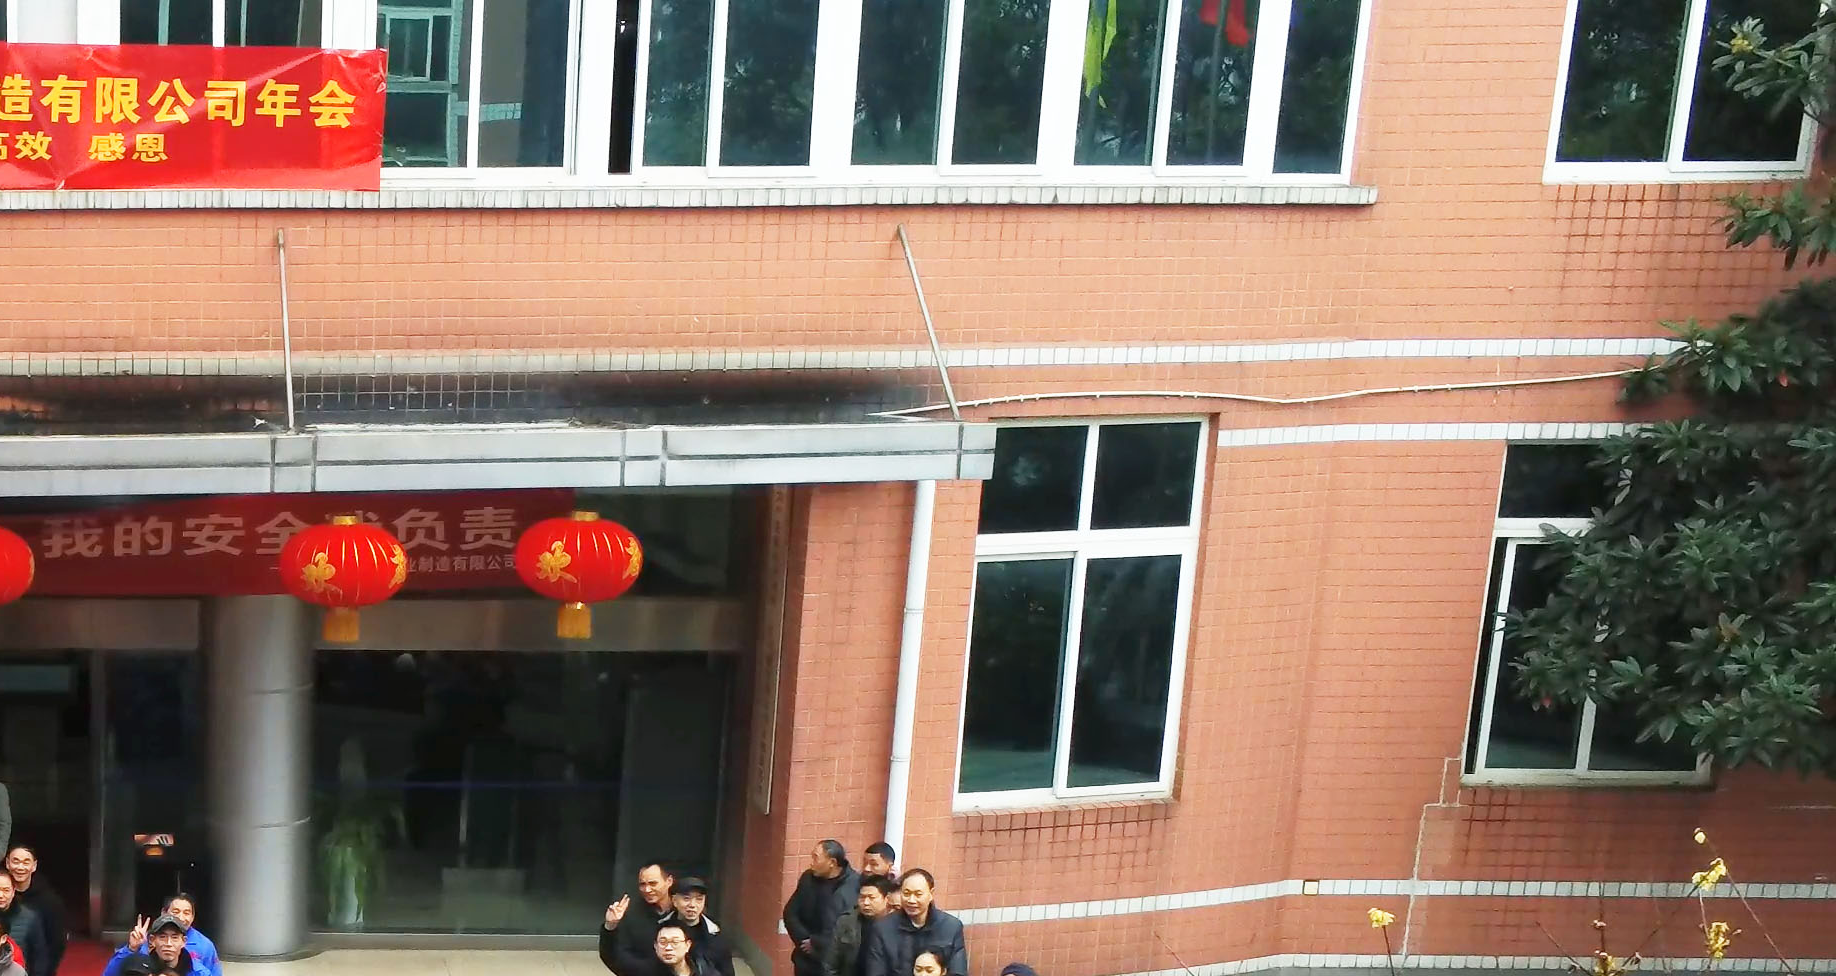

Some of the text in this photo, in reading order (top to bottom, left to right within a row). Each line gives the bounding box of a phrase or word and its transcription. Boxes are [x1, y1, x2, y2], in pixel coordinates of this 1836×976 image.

[89, 132, 168, 162] 感恩
[42, 507, 516, 558] 我的安全负责
